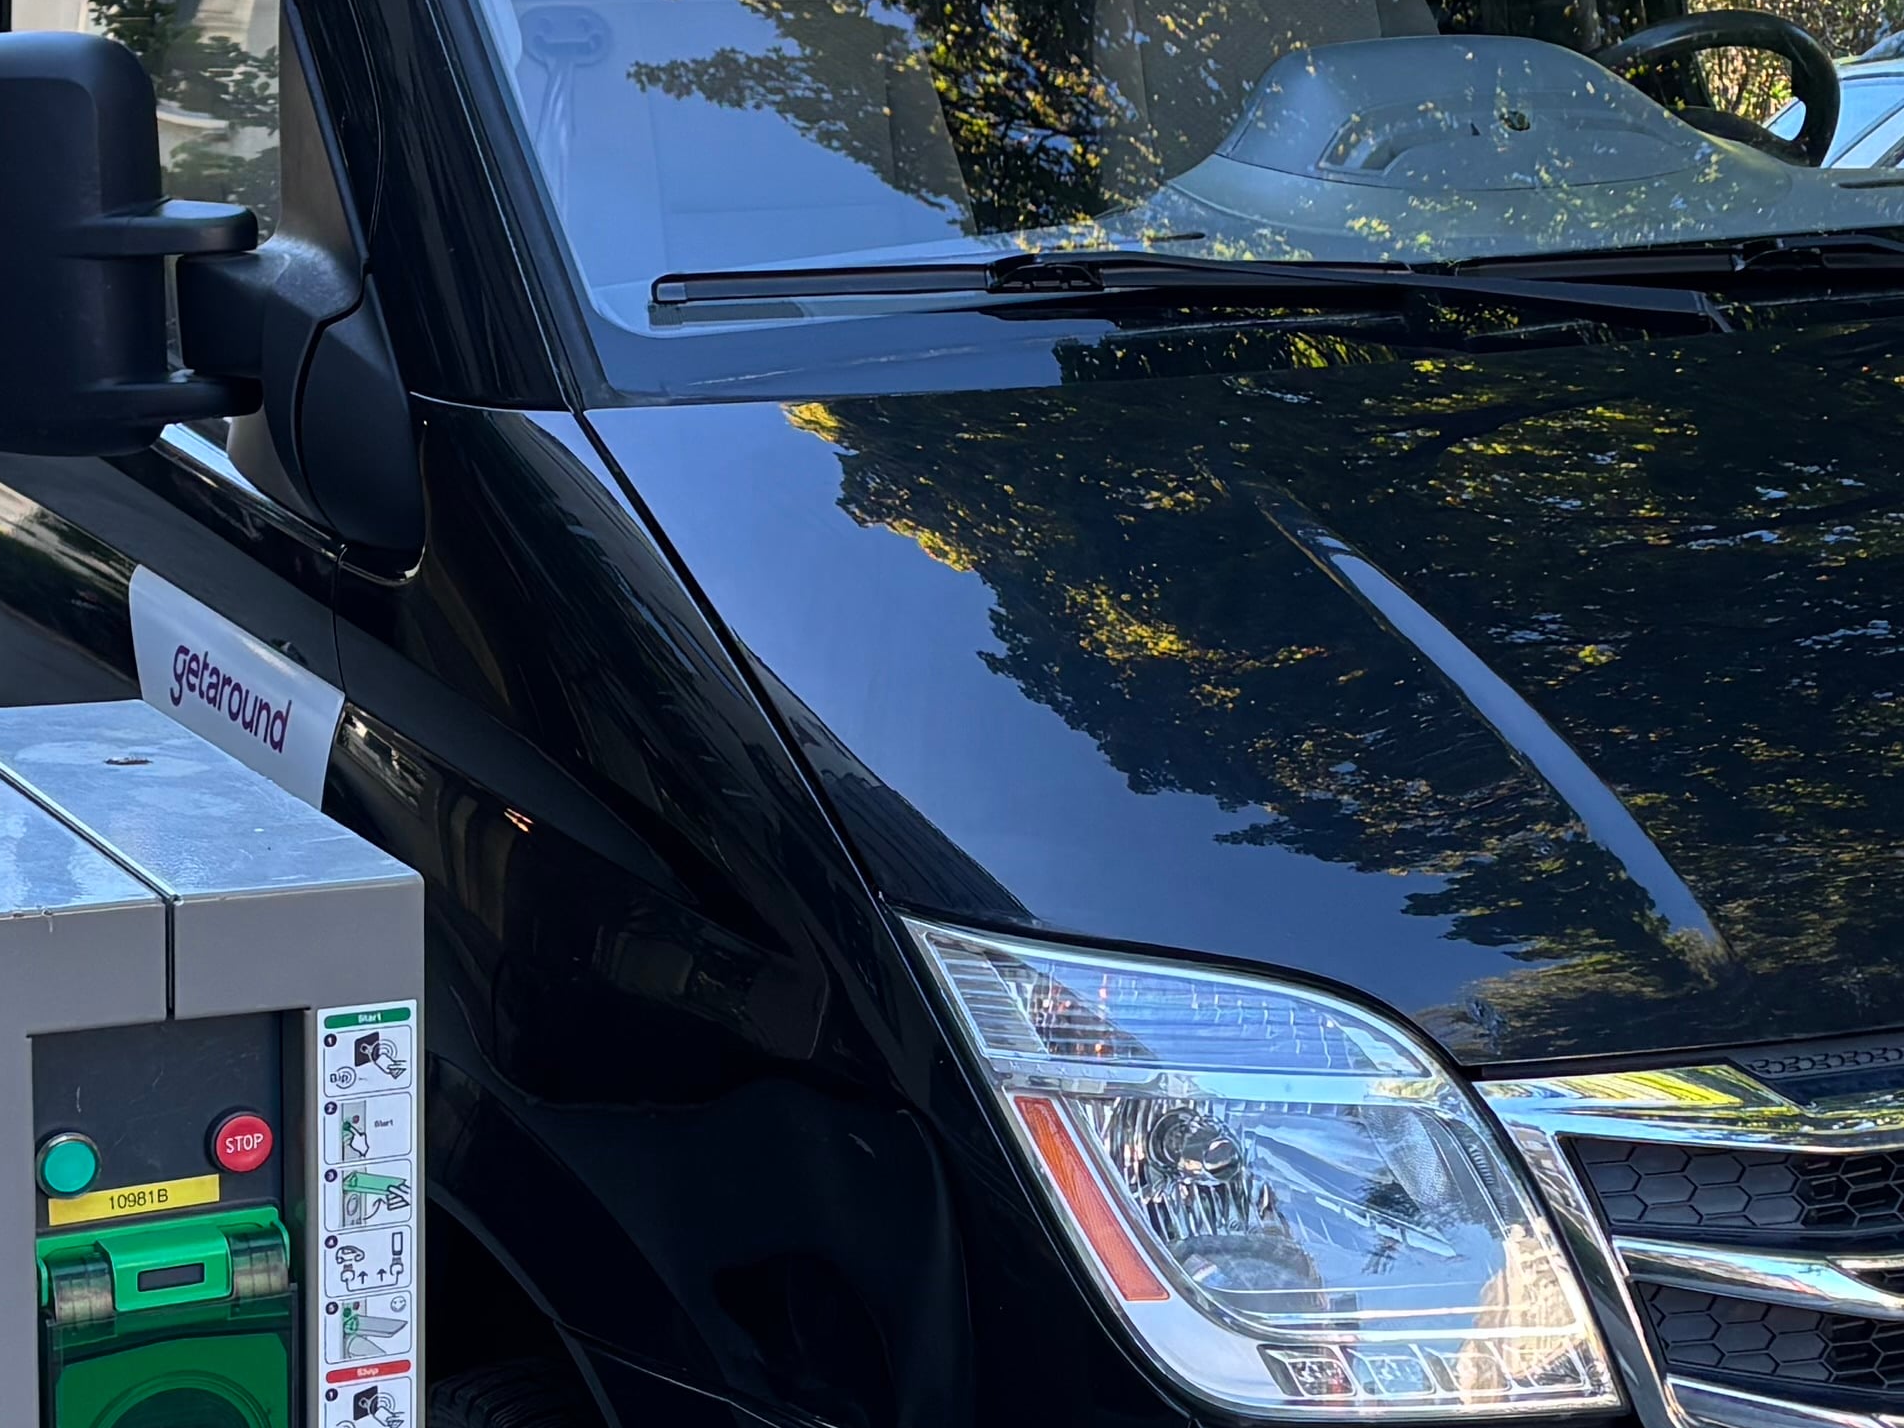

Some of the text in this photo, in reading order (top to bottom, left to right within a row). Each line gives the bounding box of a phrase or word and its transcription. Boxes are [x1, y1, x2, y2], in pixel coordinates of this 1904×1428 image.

[170, 644, 293, 754] getaround
[225, 1132, 265, 1155] STOP
[108, 1187, 169, 1211] 10981B
